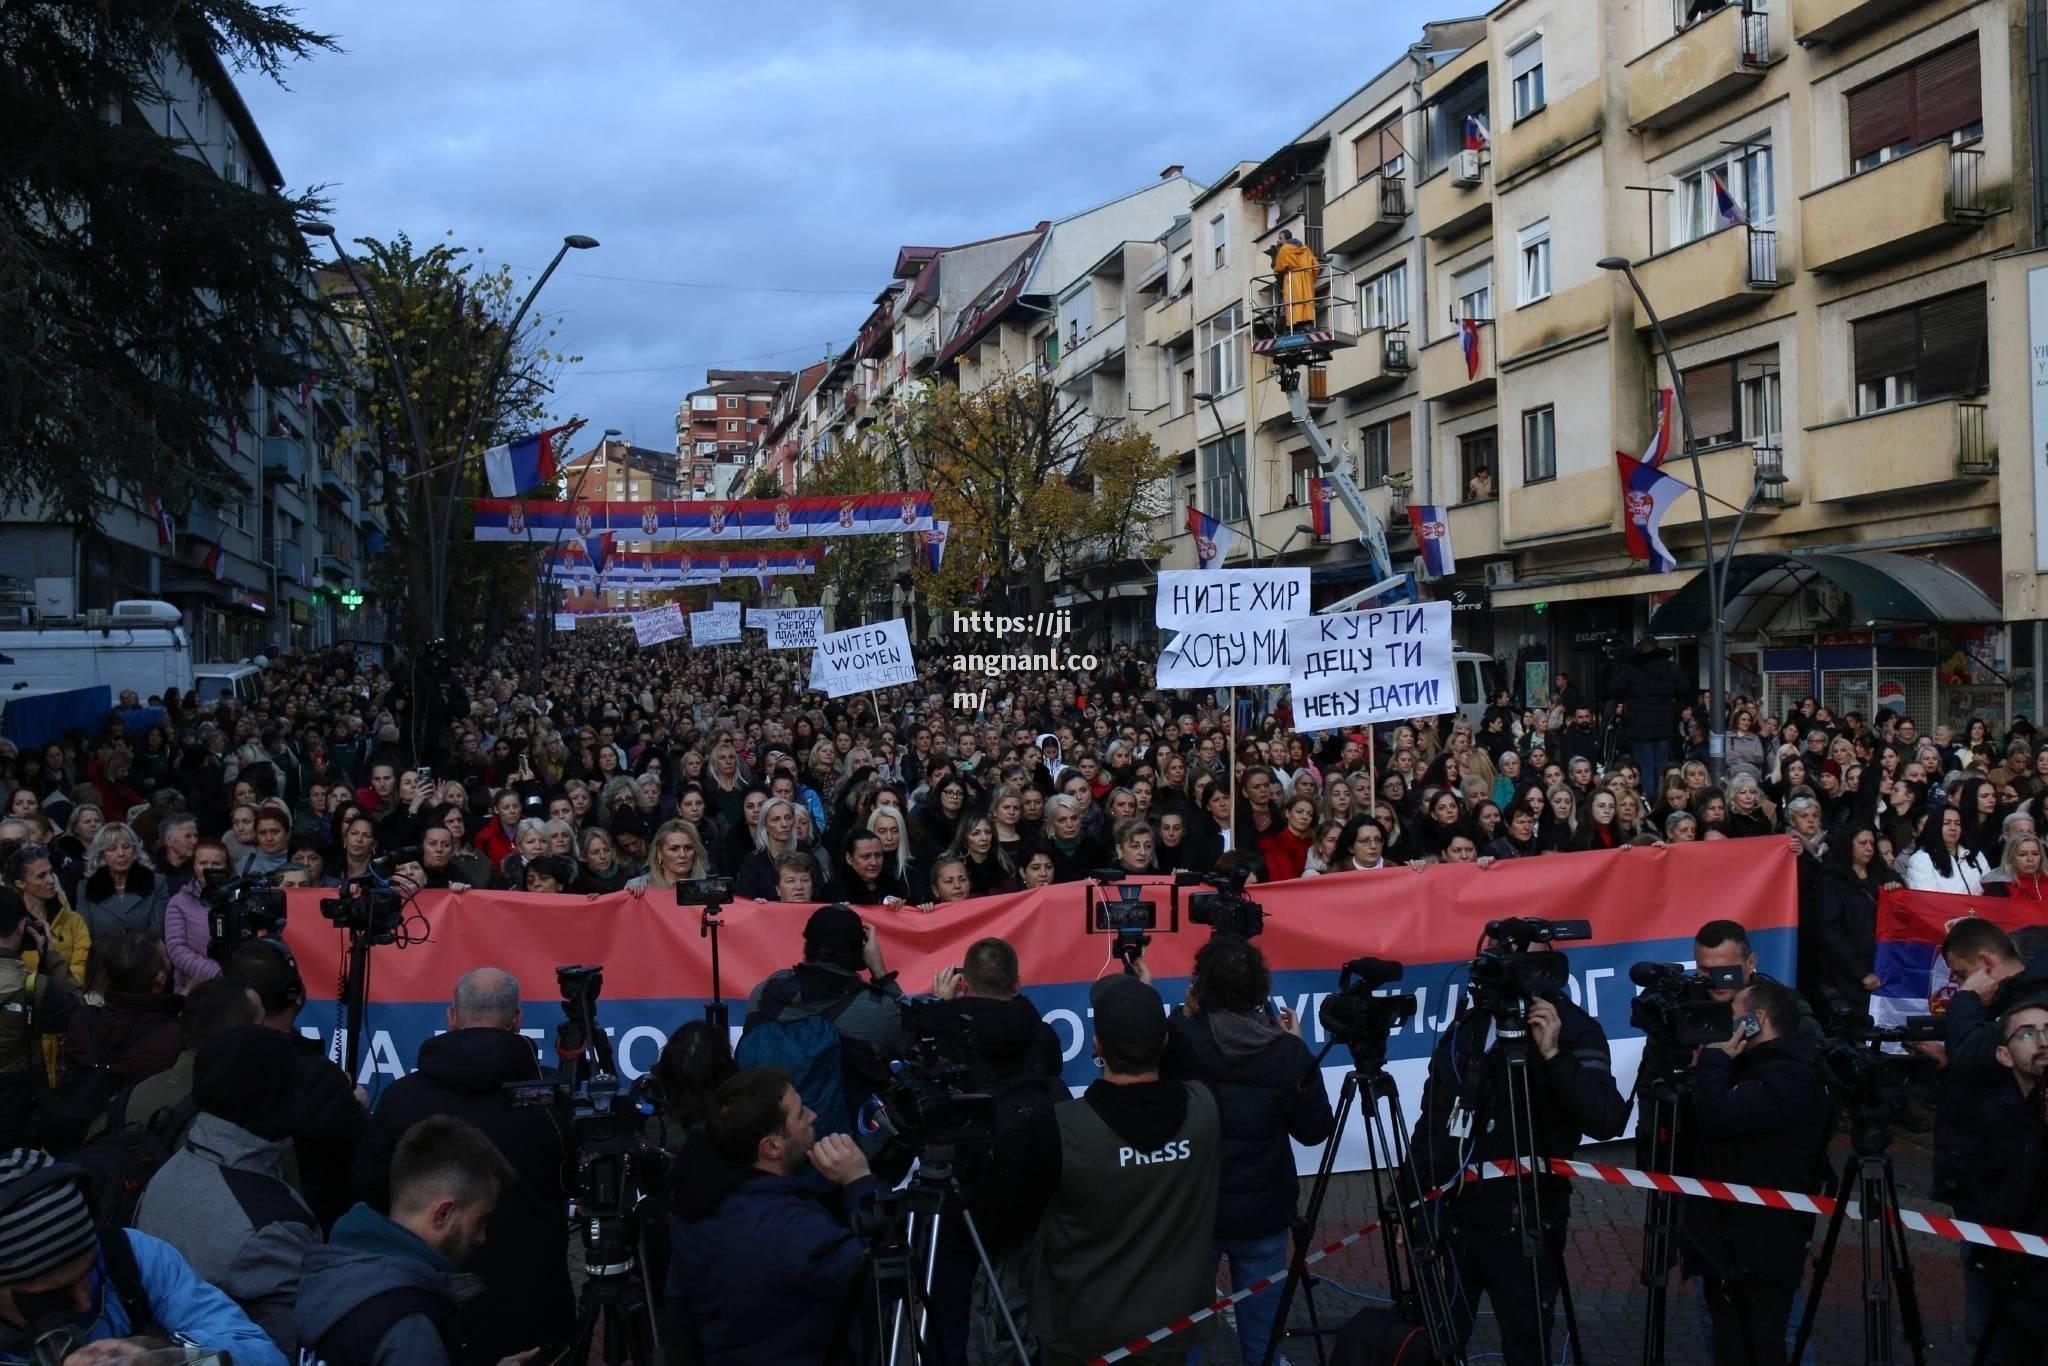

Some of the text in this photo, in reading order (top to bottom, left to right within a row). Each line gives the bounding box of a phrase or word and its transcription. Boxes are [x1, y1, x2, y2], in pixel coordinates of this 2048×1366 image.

[1173, 580, 1300, 615] НИЈЕ ХИР
[823, 629, 887, 655] UNITED
[1171, 628, 1291, 669] ХОЋУ МИ
[831, 646, 901, 672] WOMEN
[1304, 640, 1422, 679] ДЕЦУ ТИ
[826, 675, 852, 694] FREE
[1304, 679, 1439, 718] НЕЋУ ДАТИ!
[1119, 1139, 1191, 1167] PRESS
